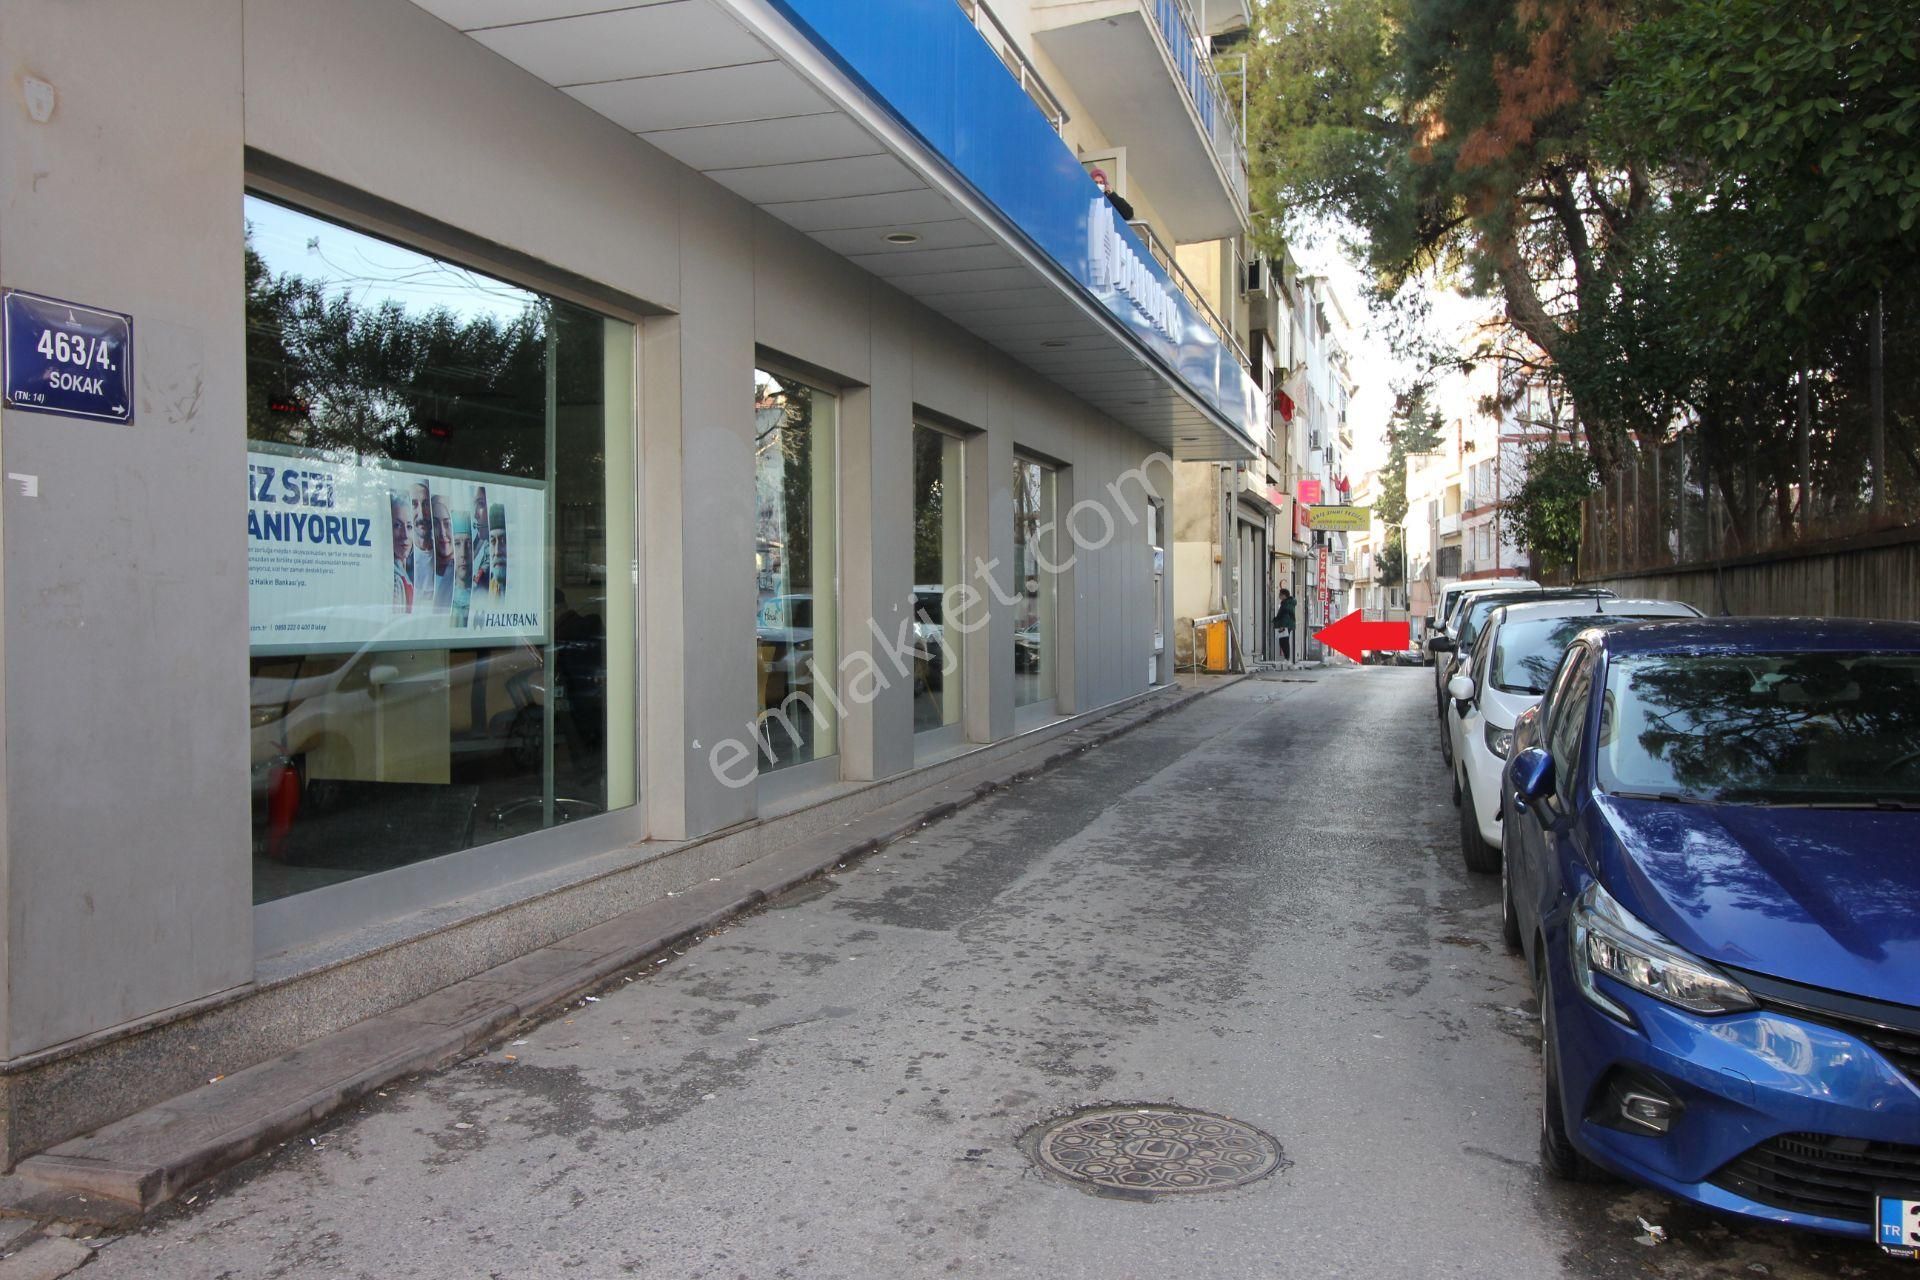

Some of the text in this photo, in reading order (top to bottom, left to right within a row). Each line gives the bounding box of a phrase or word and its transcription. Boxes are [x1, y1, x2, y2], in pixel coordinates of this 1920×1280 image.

[37, 329, 117, 372] 463/4.
[49, 371, 104, 396] SOKAK
[14, 390, 45, 404] (TN: 14)
[485, 613, 539, 627] HALKBANK
[1882, 1224, 1901, 1237] TR
